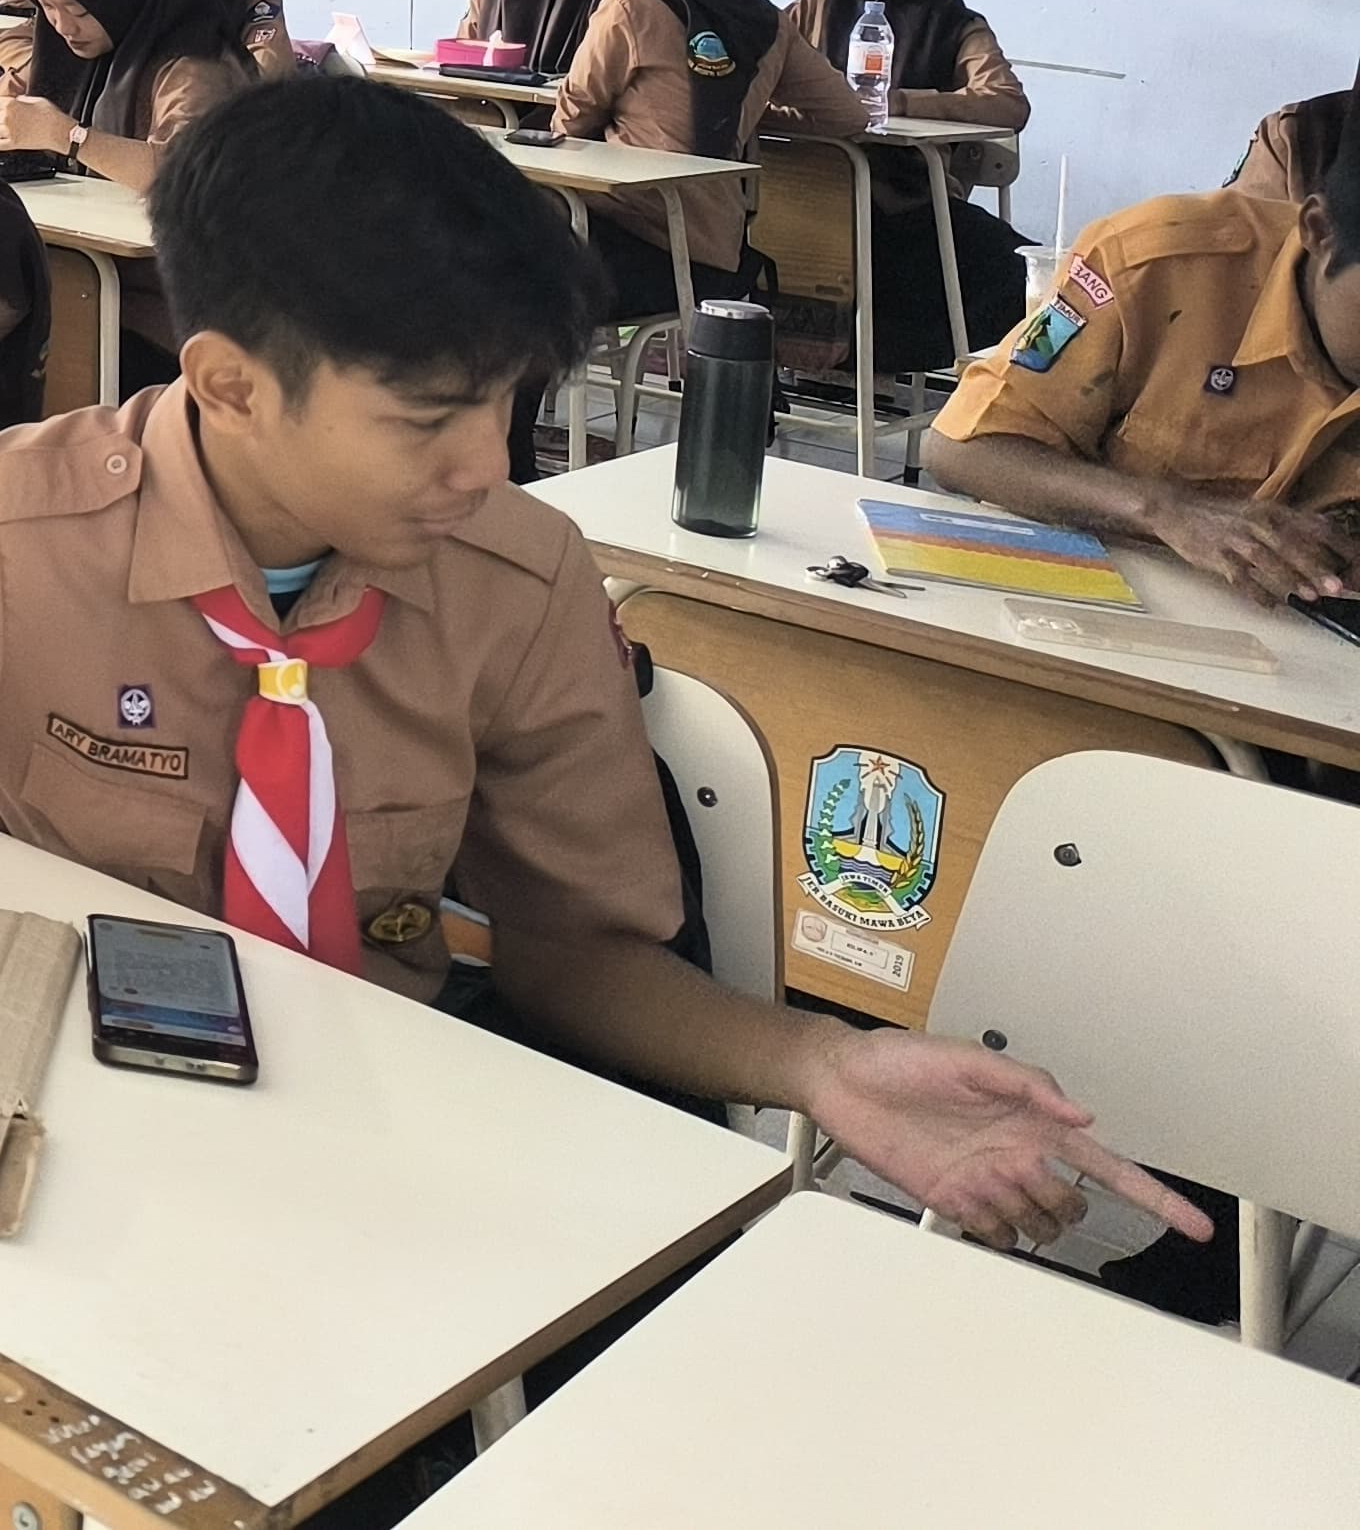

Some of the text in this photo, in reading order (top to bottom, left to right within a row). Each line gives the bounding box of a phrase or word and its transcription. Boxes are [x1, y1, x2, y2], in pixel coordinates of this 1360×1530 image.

[54, 723, 182, 772] ARY BRAMATYO
[804, 876, 924, 928] JER BASUKI MAWA BEYA
